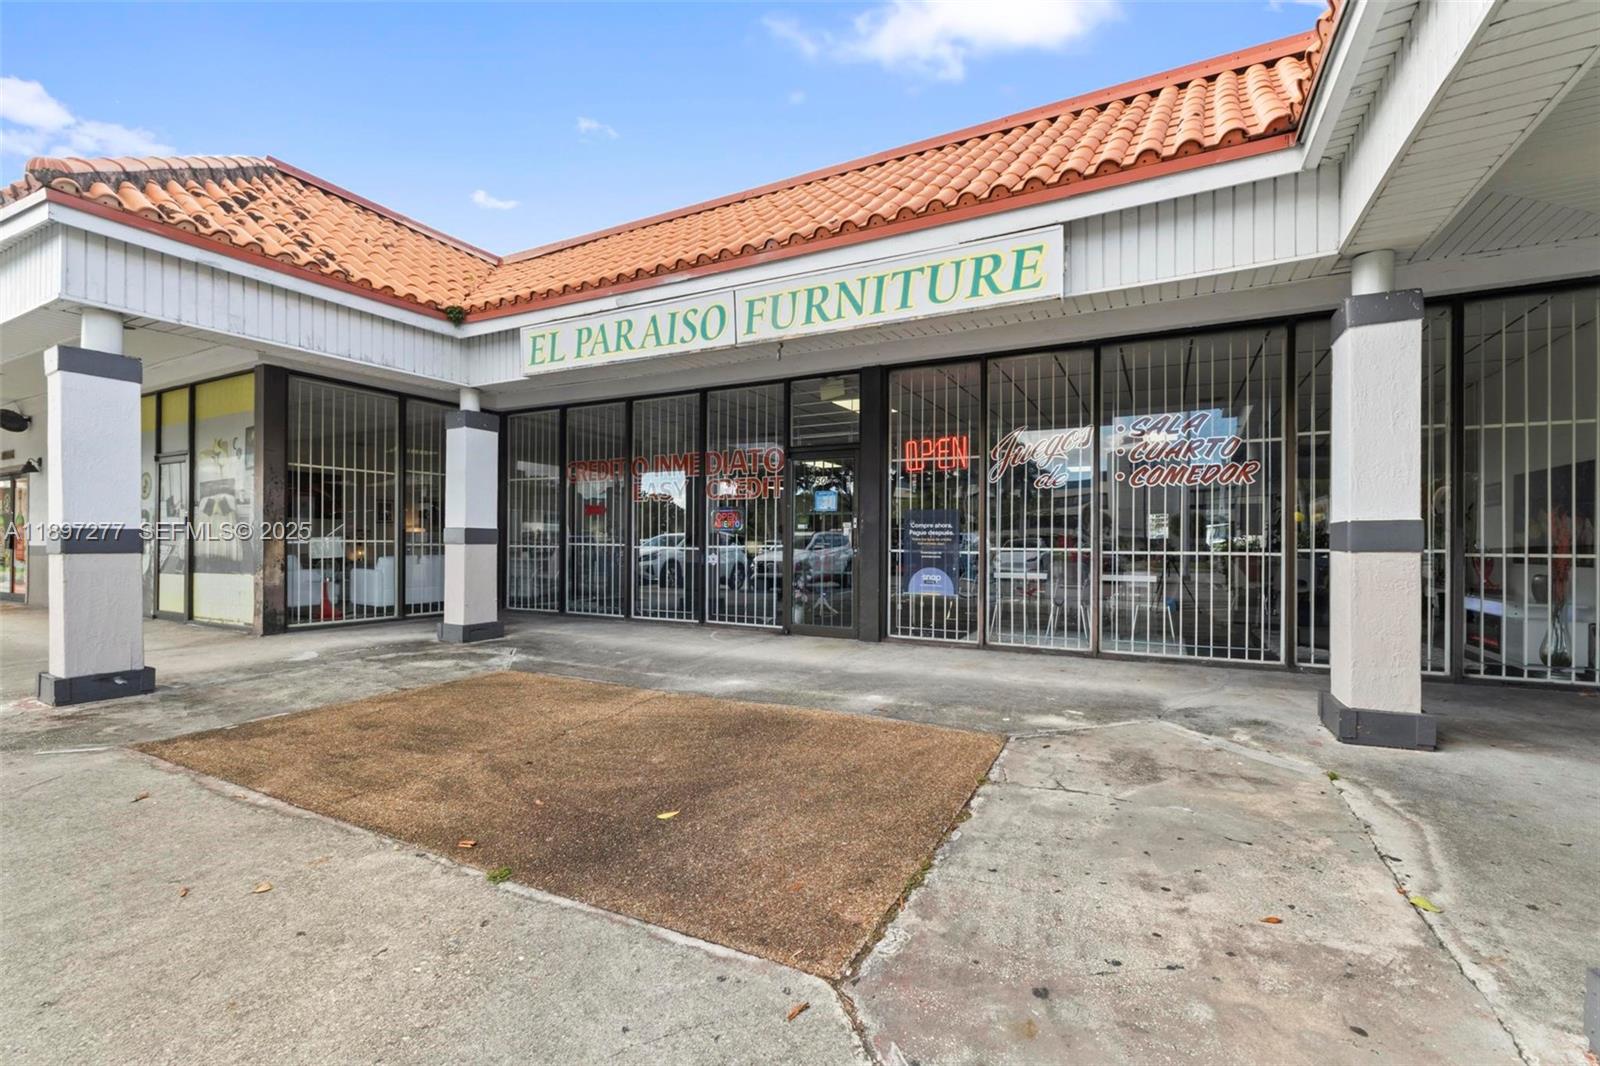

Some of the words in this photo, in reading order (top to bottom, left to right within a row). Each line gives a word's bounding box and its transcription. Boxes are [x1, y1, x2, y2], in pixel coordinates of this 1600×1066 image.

[528, 331, 566, 367] EL
[573, 304, 727, 360] PARAISO
[742, 244, 1045, 337] FURNITURE
[1129, 411, 1210, 438] SALA
[905, 436, 968, 472] OPEN
[989, 424, 1095, 484] Juegos
[1128, 435, 1243, 463] CUARTO
[706, 476, 785, 501] CREDIT
[1034, 463, 1069, 489] de
[1128, 460, 1262, 489] COMEDOR
